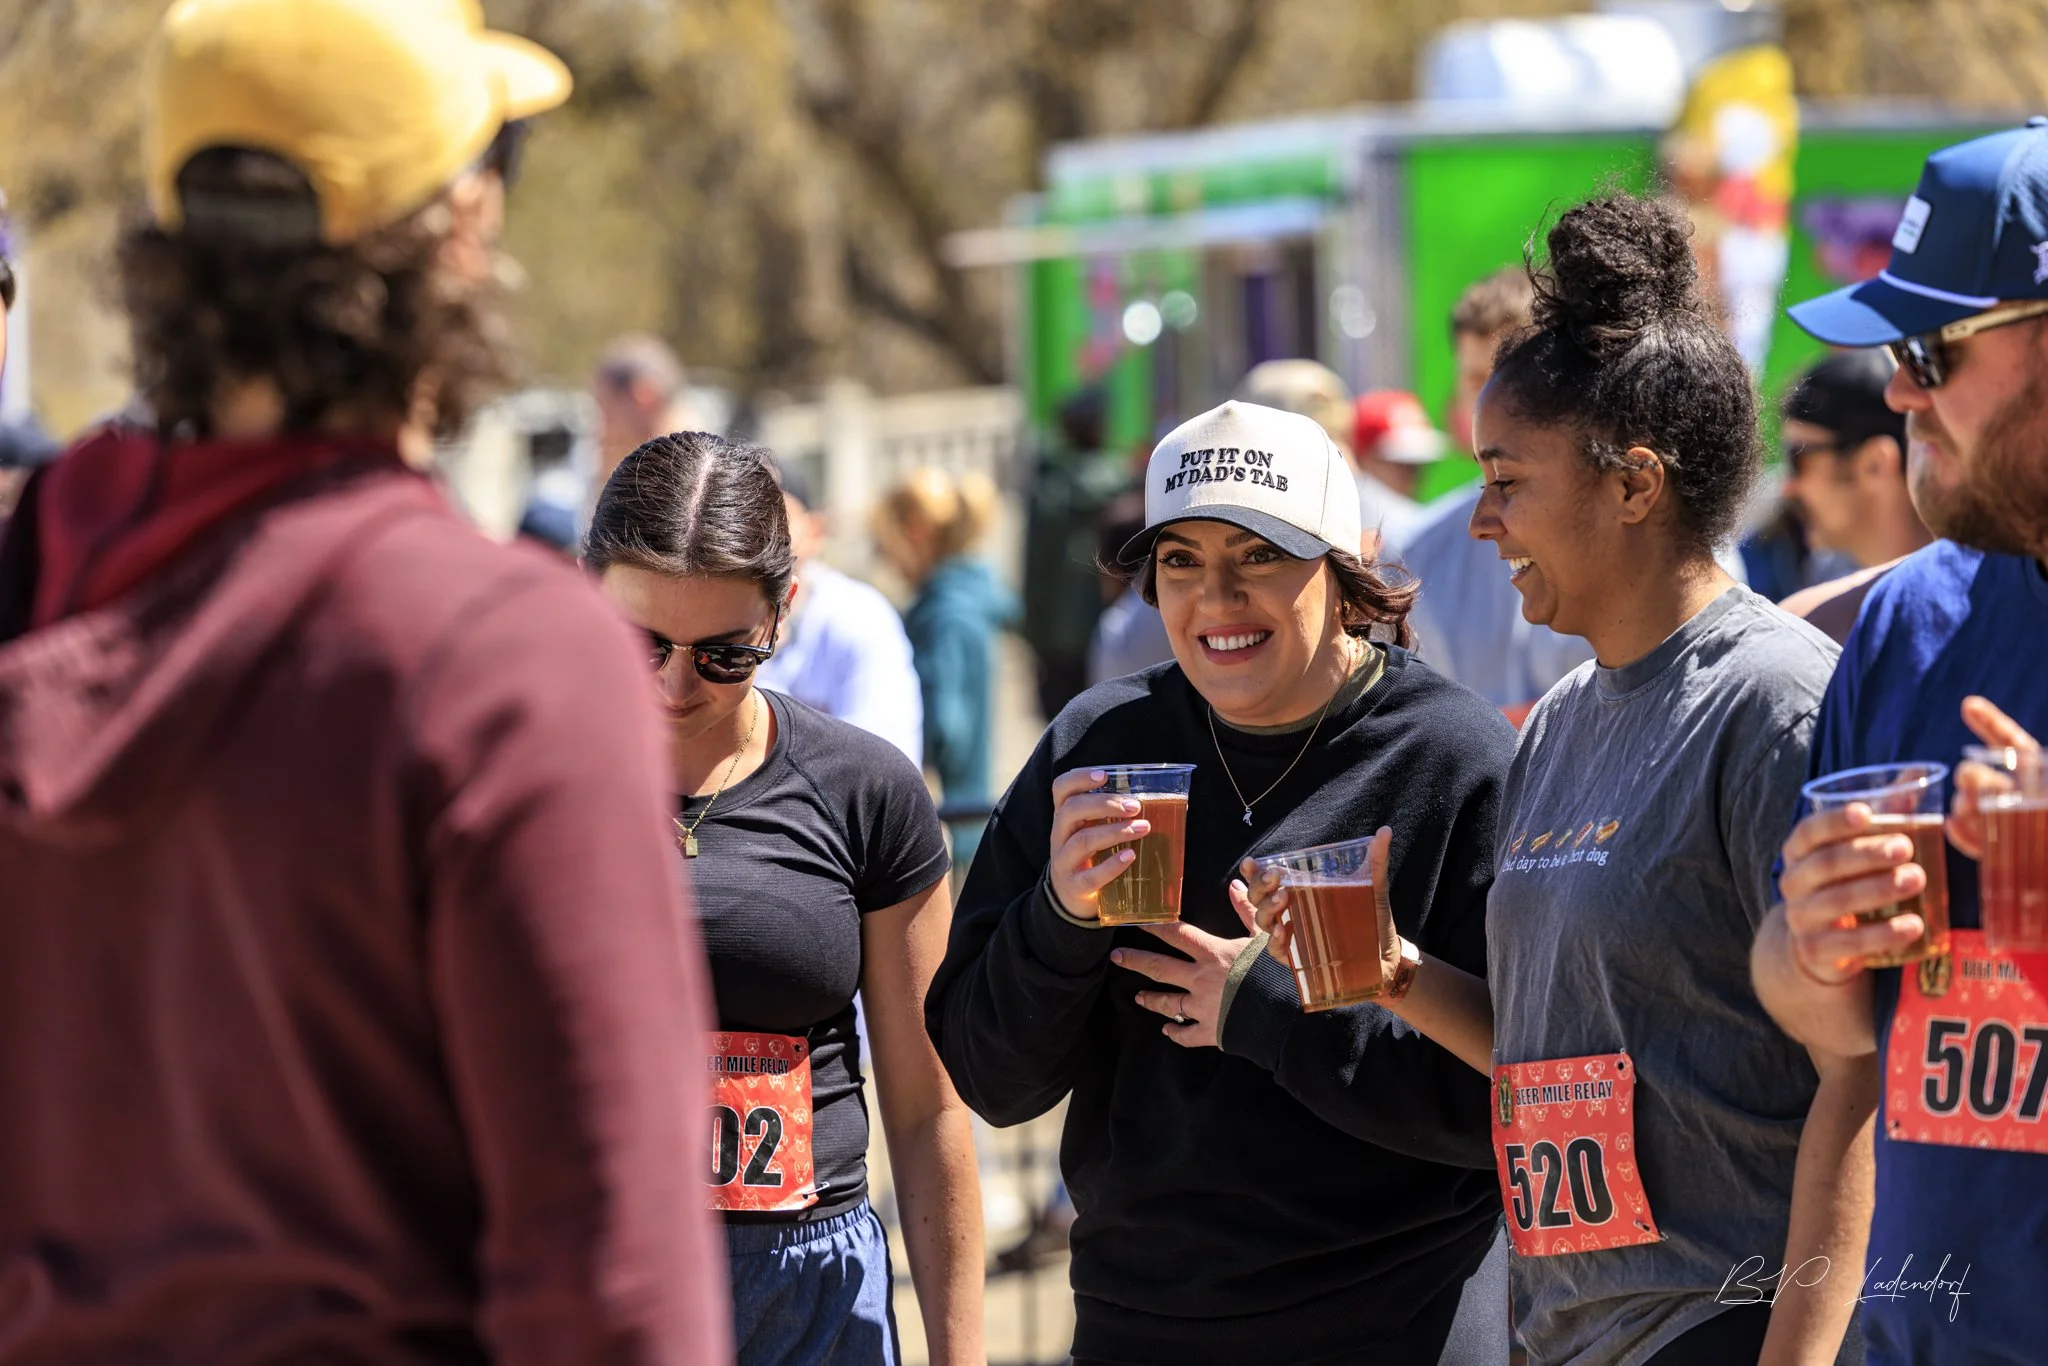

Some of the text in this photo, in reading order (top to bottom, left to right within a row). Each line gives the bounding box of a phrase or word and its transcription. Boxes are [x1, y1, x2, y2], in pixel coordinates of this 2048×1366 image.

[1179, 447, 1273, 469] PUT IT ON
[1164, 465, 1289, 494] MY DAD'S TAB
[1516, 855, 1537, 873] day
[1537, 855, 1550, 869] to
[1586, 846, 1610, 867] dog
[726, 1055, 757, 1074] MILE
[759, 1057, 790, 1075] RELAY
[1923, 1014, 2048, 1124] 507
[1515, 1080, 1614, 1106] BEER MILE RELAY
[702, 1104, 784, 1188] 02
[1505, 1136, 1615, 1232] 520
